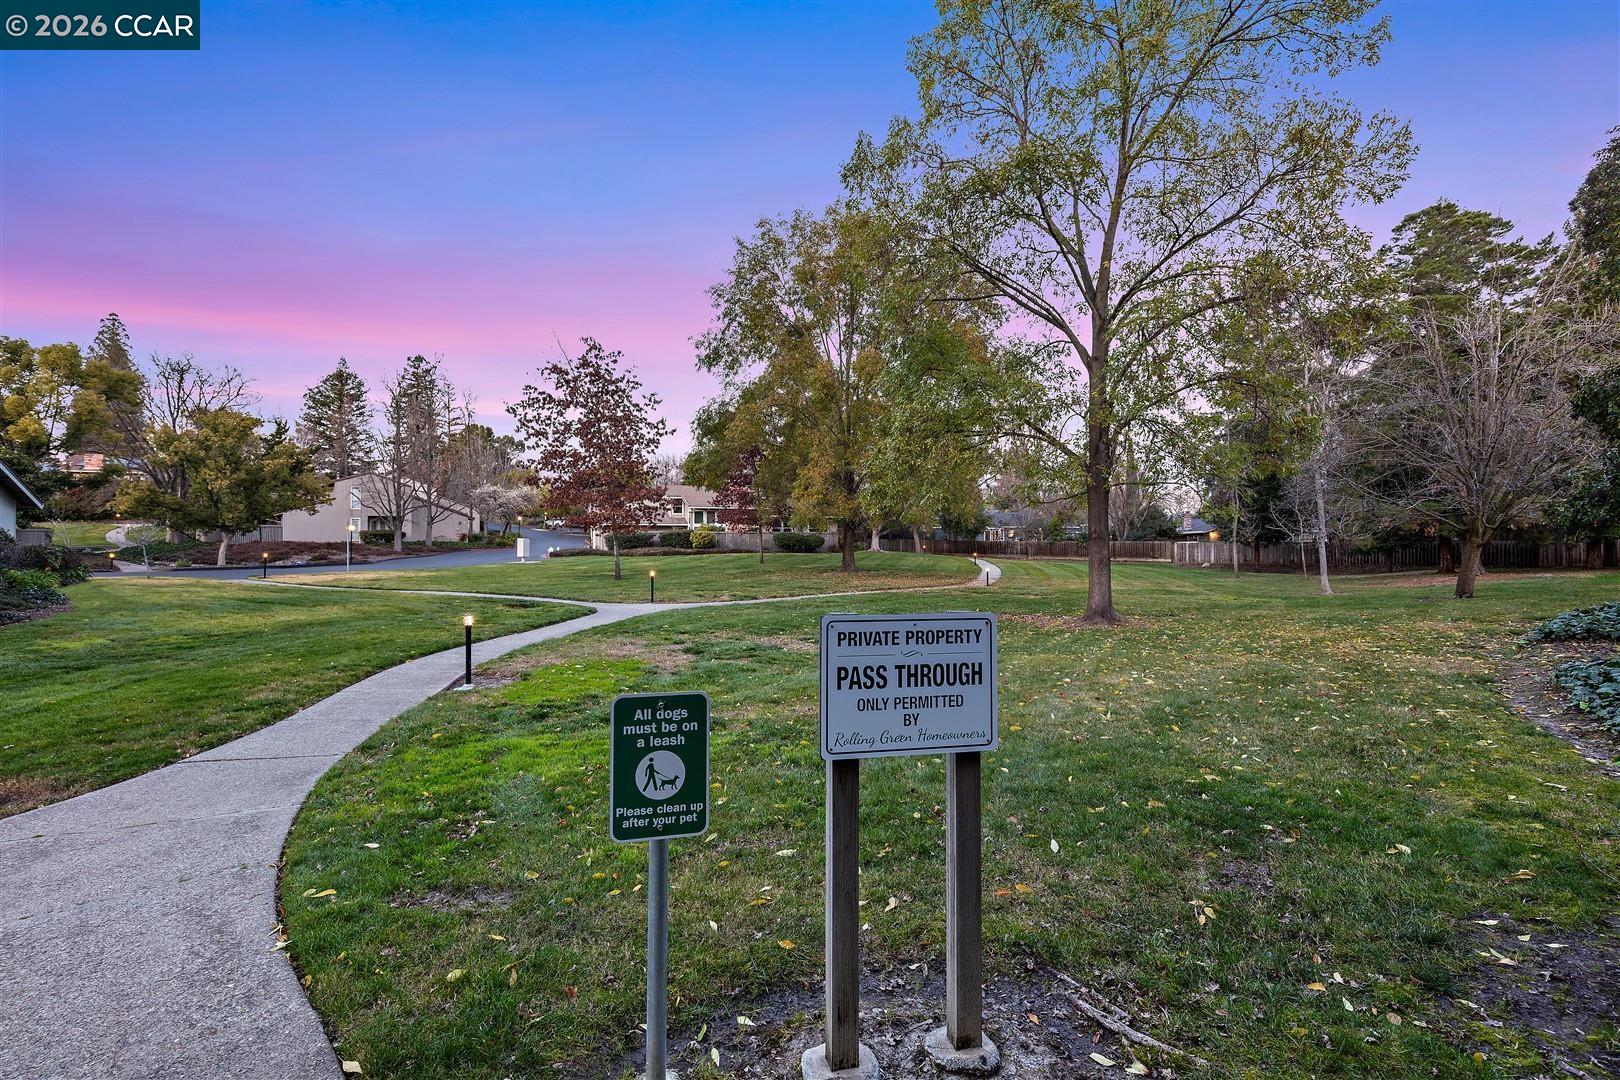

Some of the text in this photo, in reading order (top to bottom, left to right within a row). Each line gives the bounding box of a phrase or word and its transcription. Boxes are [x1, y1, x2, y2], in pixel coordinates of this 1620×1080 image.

[837, 629, 983, 647] PRIVATE PROPERTY
[836, 662, 983, 690] PASS THROUGH
[857, 694, 964, 712] ONLY PERMITTED
[634, 708, 688, 721] All dogs
[903, 713, 920, 727] BY
[623, 721, 698, 735] must be on
[636, 734, 685, 748] a leash
[834, 728, 986, 749] Rolling Green Homeowners
[616, 802, 704, 817] Please clean up
[622, 812, 698, 828] after your pet
